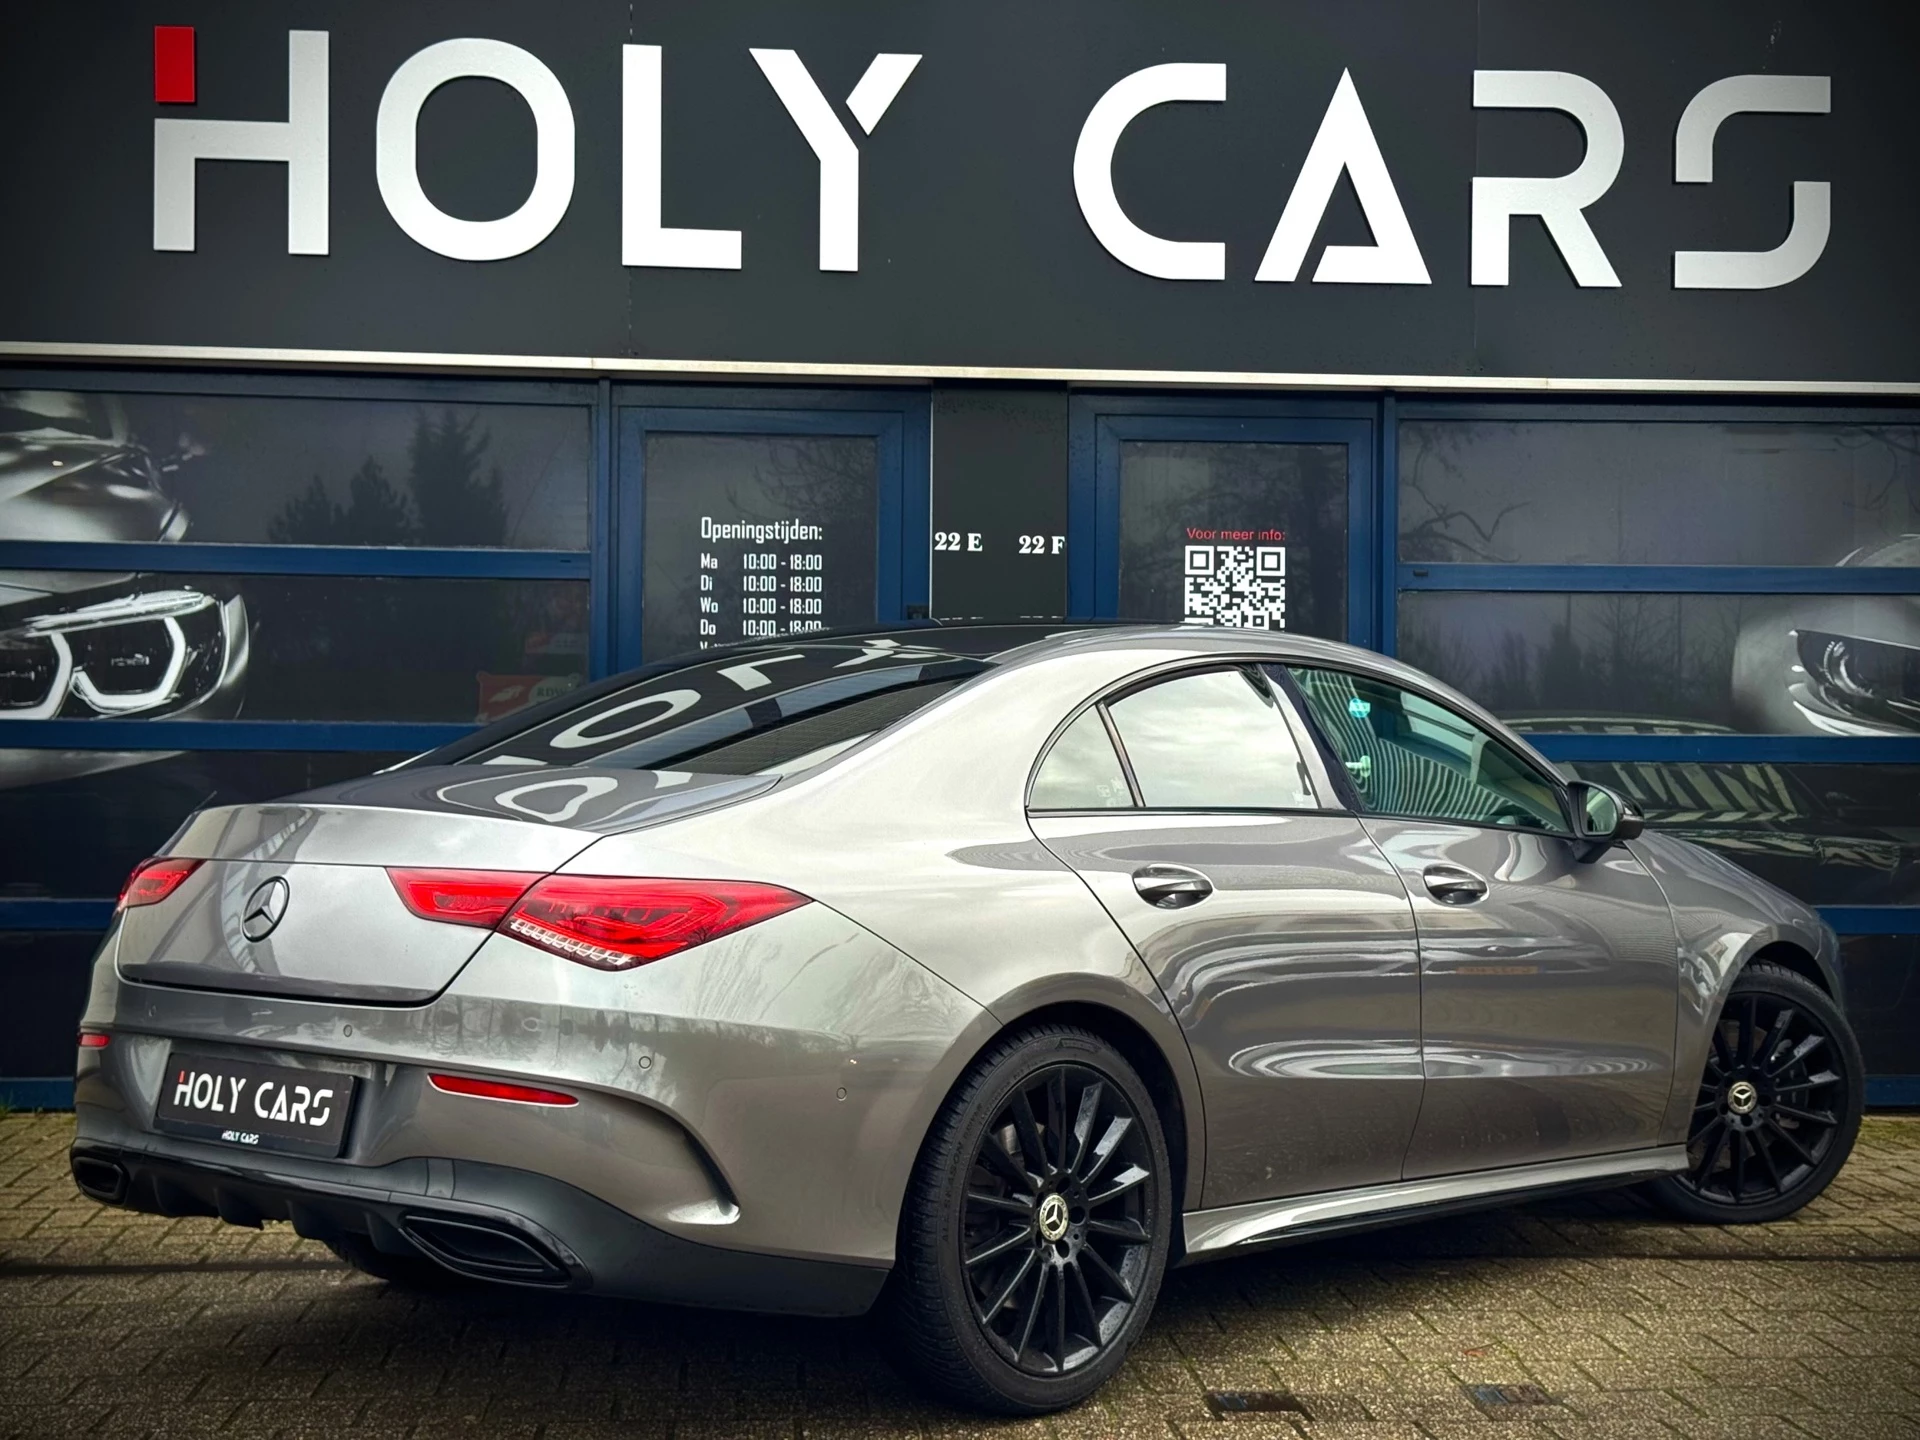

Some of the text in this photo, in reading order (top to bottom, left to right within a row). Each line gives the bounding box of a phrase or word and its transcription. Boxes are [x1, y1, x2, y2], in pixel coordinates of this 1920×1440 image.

[153, 25, 1832, 290] HOLY CARS
[700, 516, 823, 544] Openingstijden:
[1186, 527, 1286, 541] Voor meer info:
[933, 532, 983, 552] 22 E
[1018, 535, 1066, 555] 22 F
[700, 552, 718, 569] Ma
[743, 553, 777, 570] 10:00
[790, 554, 823, 571] 18:00
[700, 574, 713, 591] Di
[743, 575, 777, 592] 10:00
[790, 576, 823, 592] 18:00
[700, 596, 719, 614] Wo
[743, 597, 777, 614] 10:00
[790, 598, 823, 614] 18:00
[700, 618, 717, 636] Do
[743, 619, 777, 636] 10:00
[789, 620, 823, 634] 18:00
[173, 1069, 334, 1127] HOLY CARS
[221, 1130, 260, 1145] HOLY CARS
